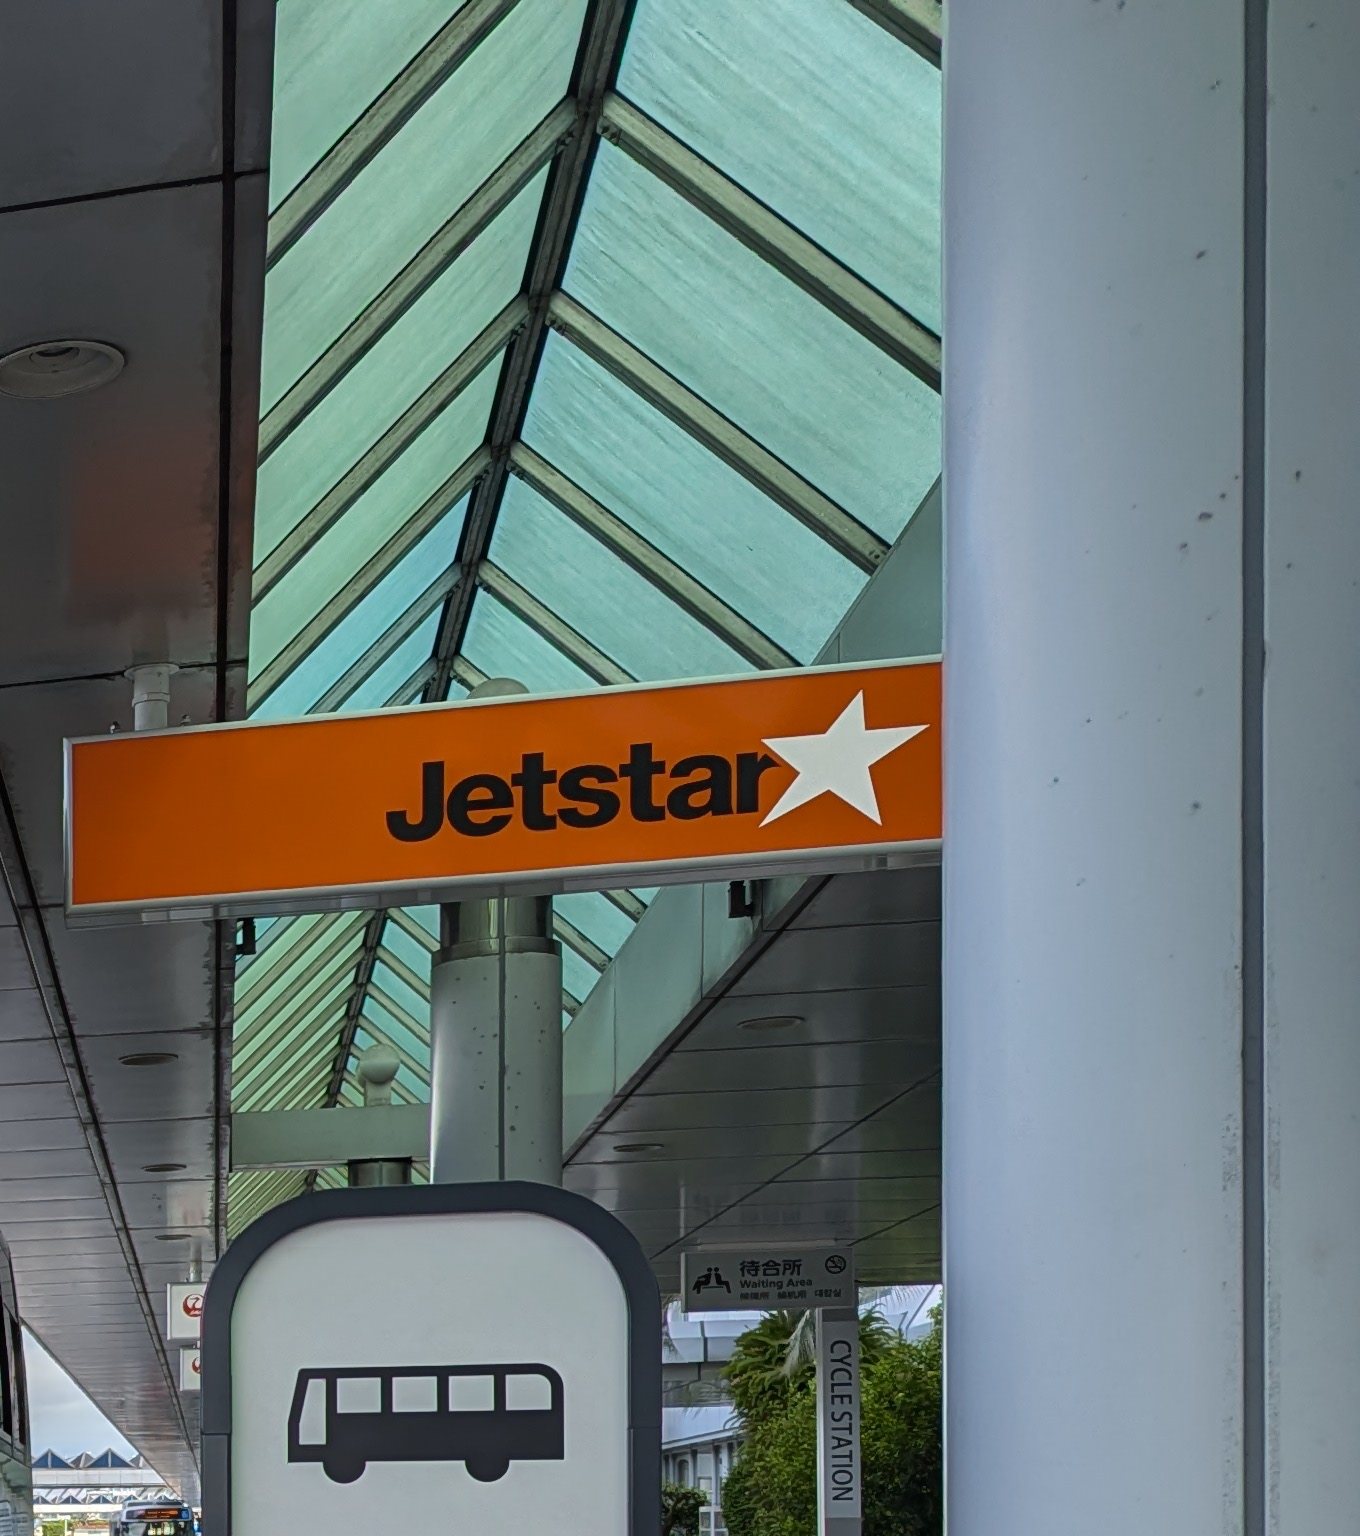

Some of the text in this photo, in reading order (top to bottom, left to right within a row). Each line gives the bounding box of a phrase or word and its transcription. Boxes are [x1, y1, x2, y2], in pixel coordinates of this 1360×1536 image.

[386, 742, 782, 843] Jetstar
[740, 1259, 803, 1278] 待合所
[740, 1278, 813, 1290] Waiting Area
[830, 1340, 854, 1501] CYCLE STATION
